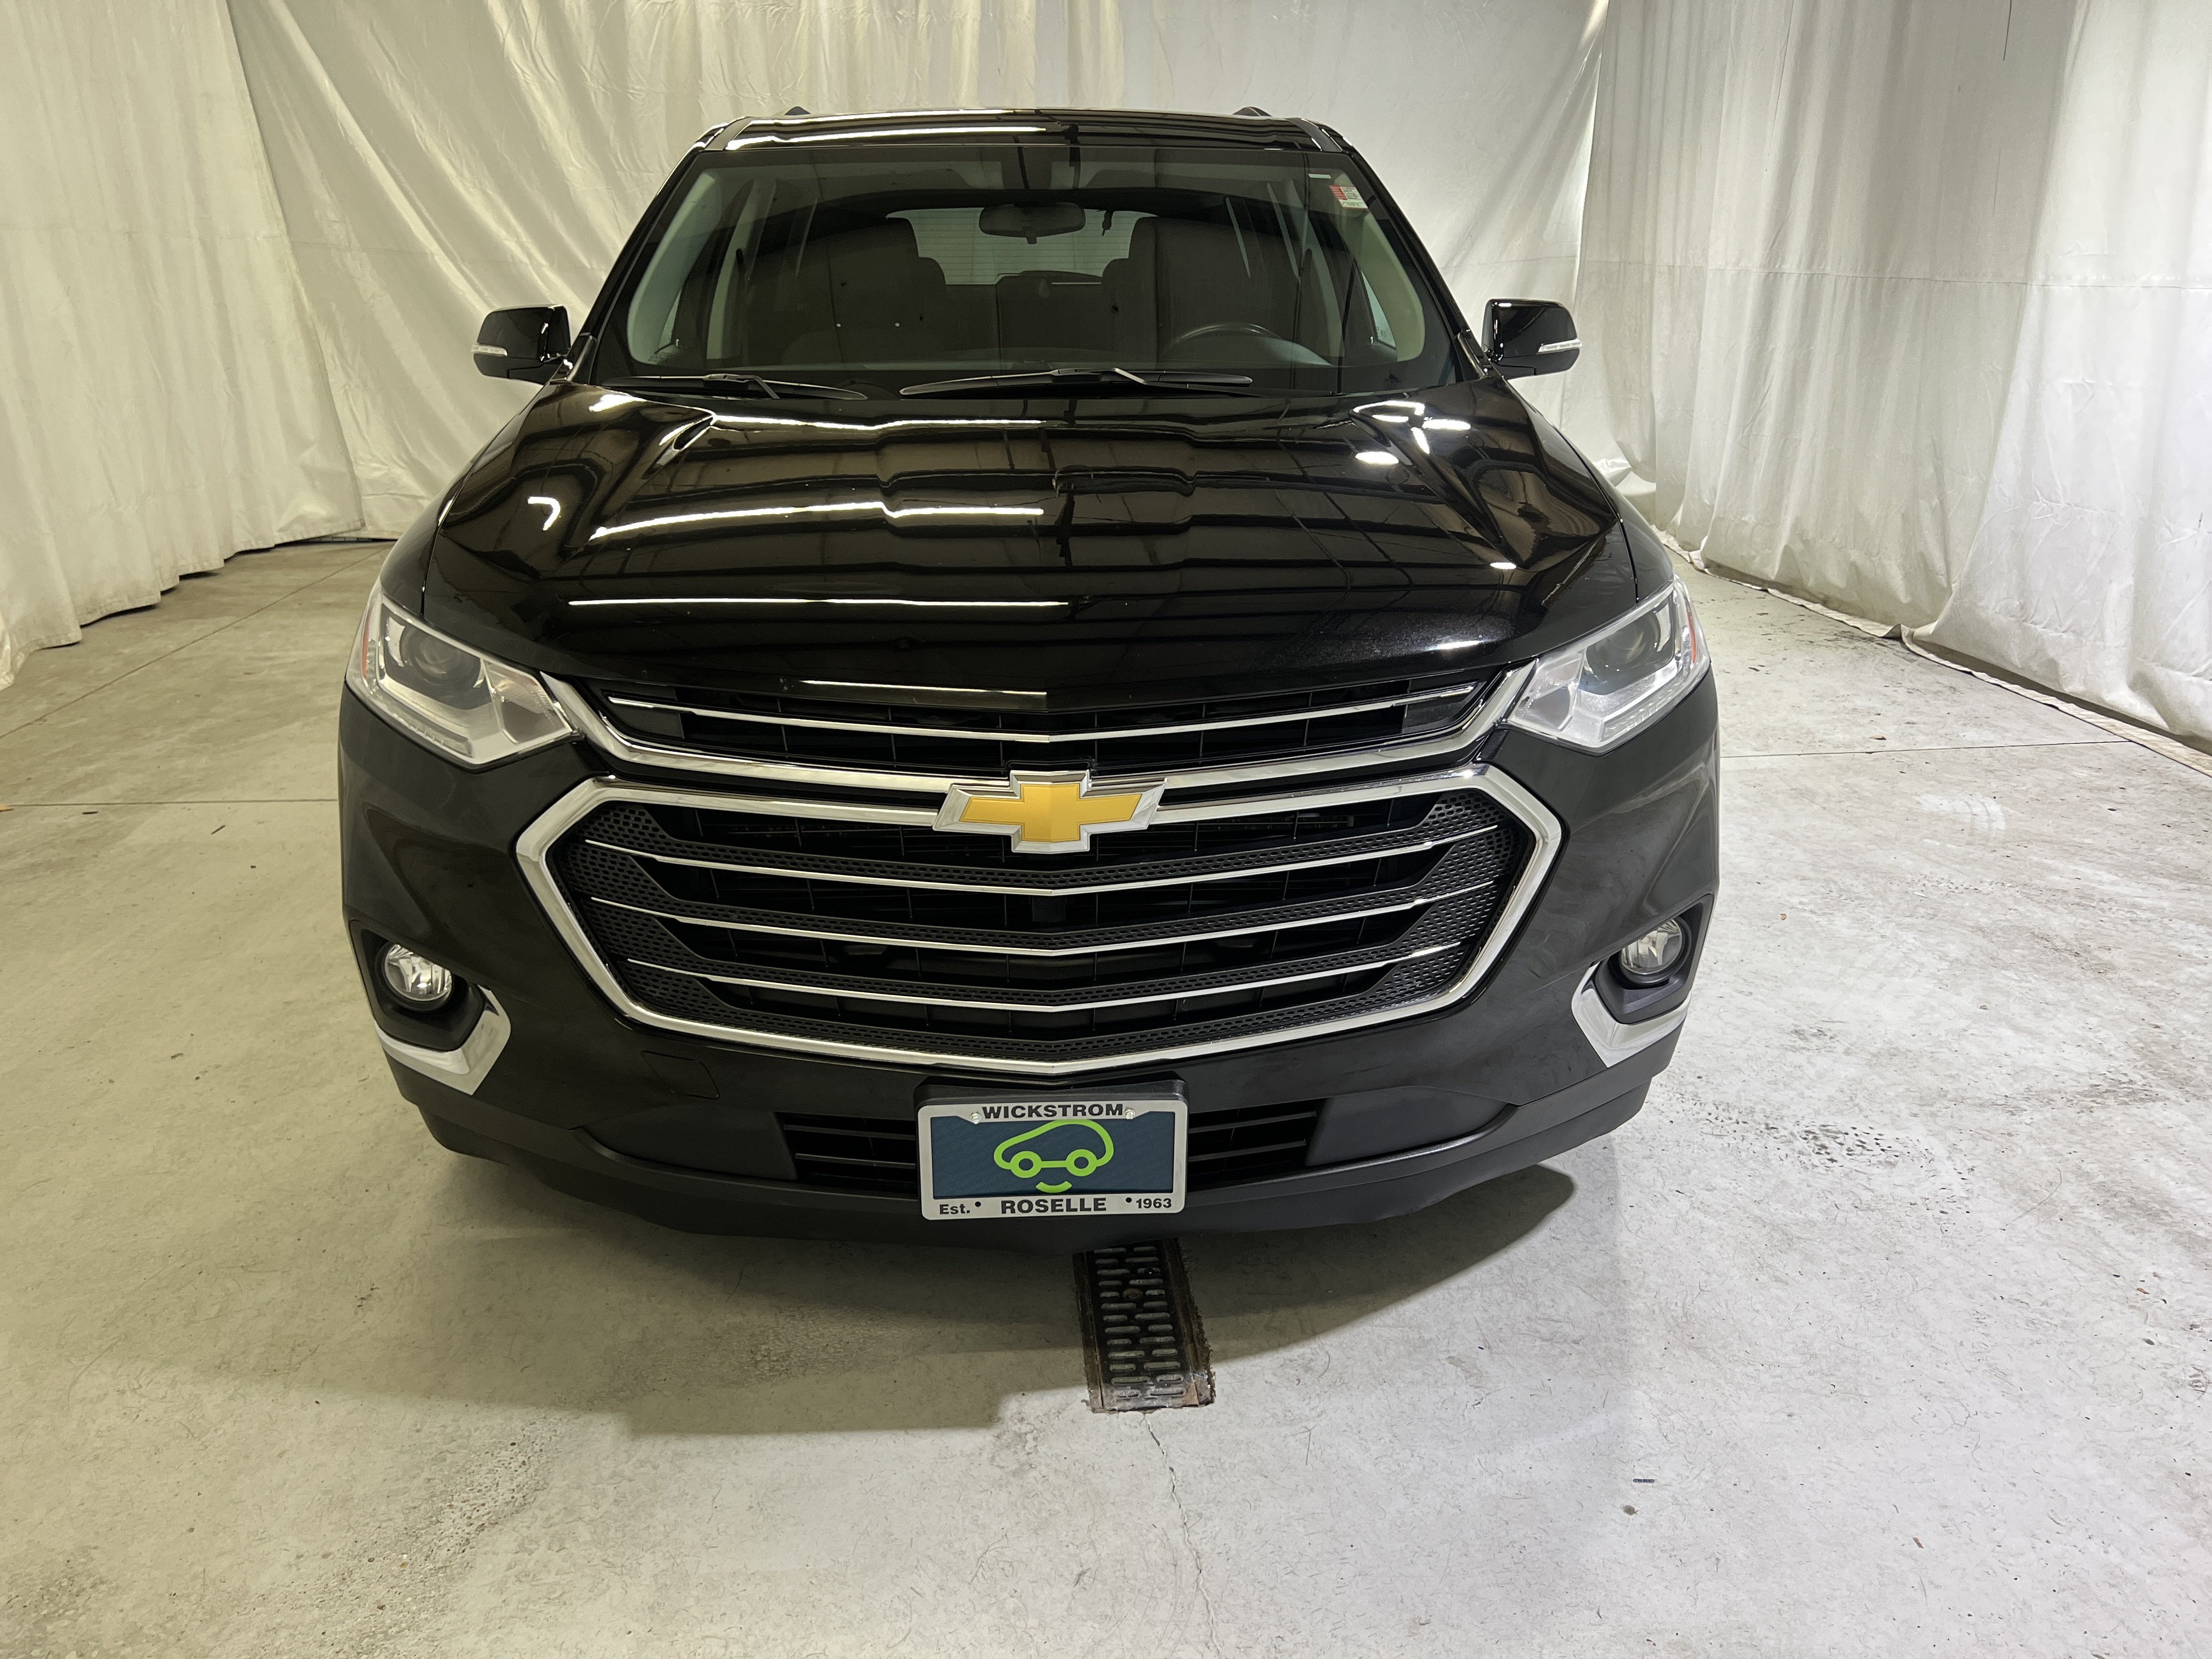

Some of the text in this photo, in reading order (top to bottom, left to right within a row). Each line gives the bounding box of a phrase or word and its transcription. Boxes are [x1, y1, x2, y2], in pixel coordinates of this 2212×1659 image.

[982, 1103, 1123, 1119] WICKSTROM
[939, 1197, 1172, 1215] Est. ROSELLE 1963
